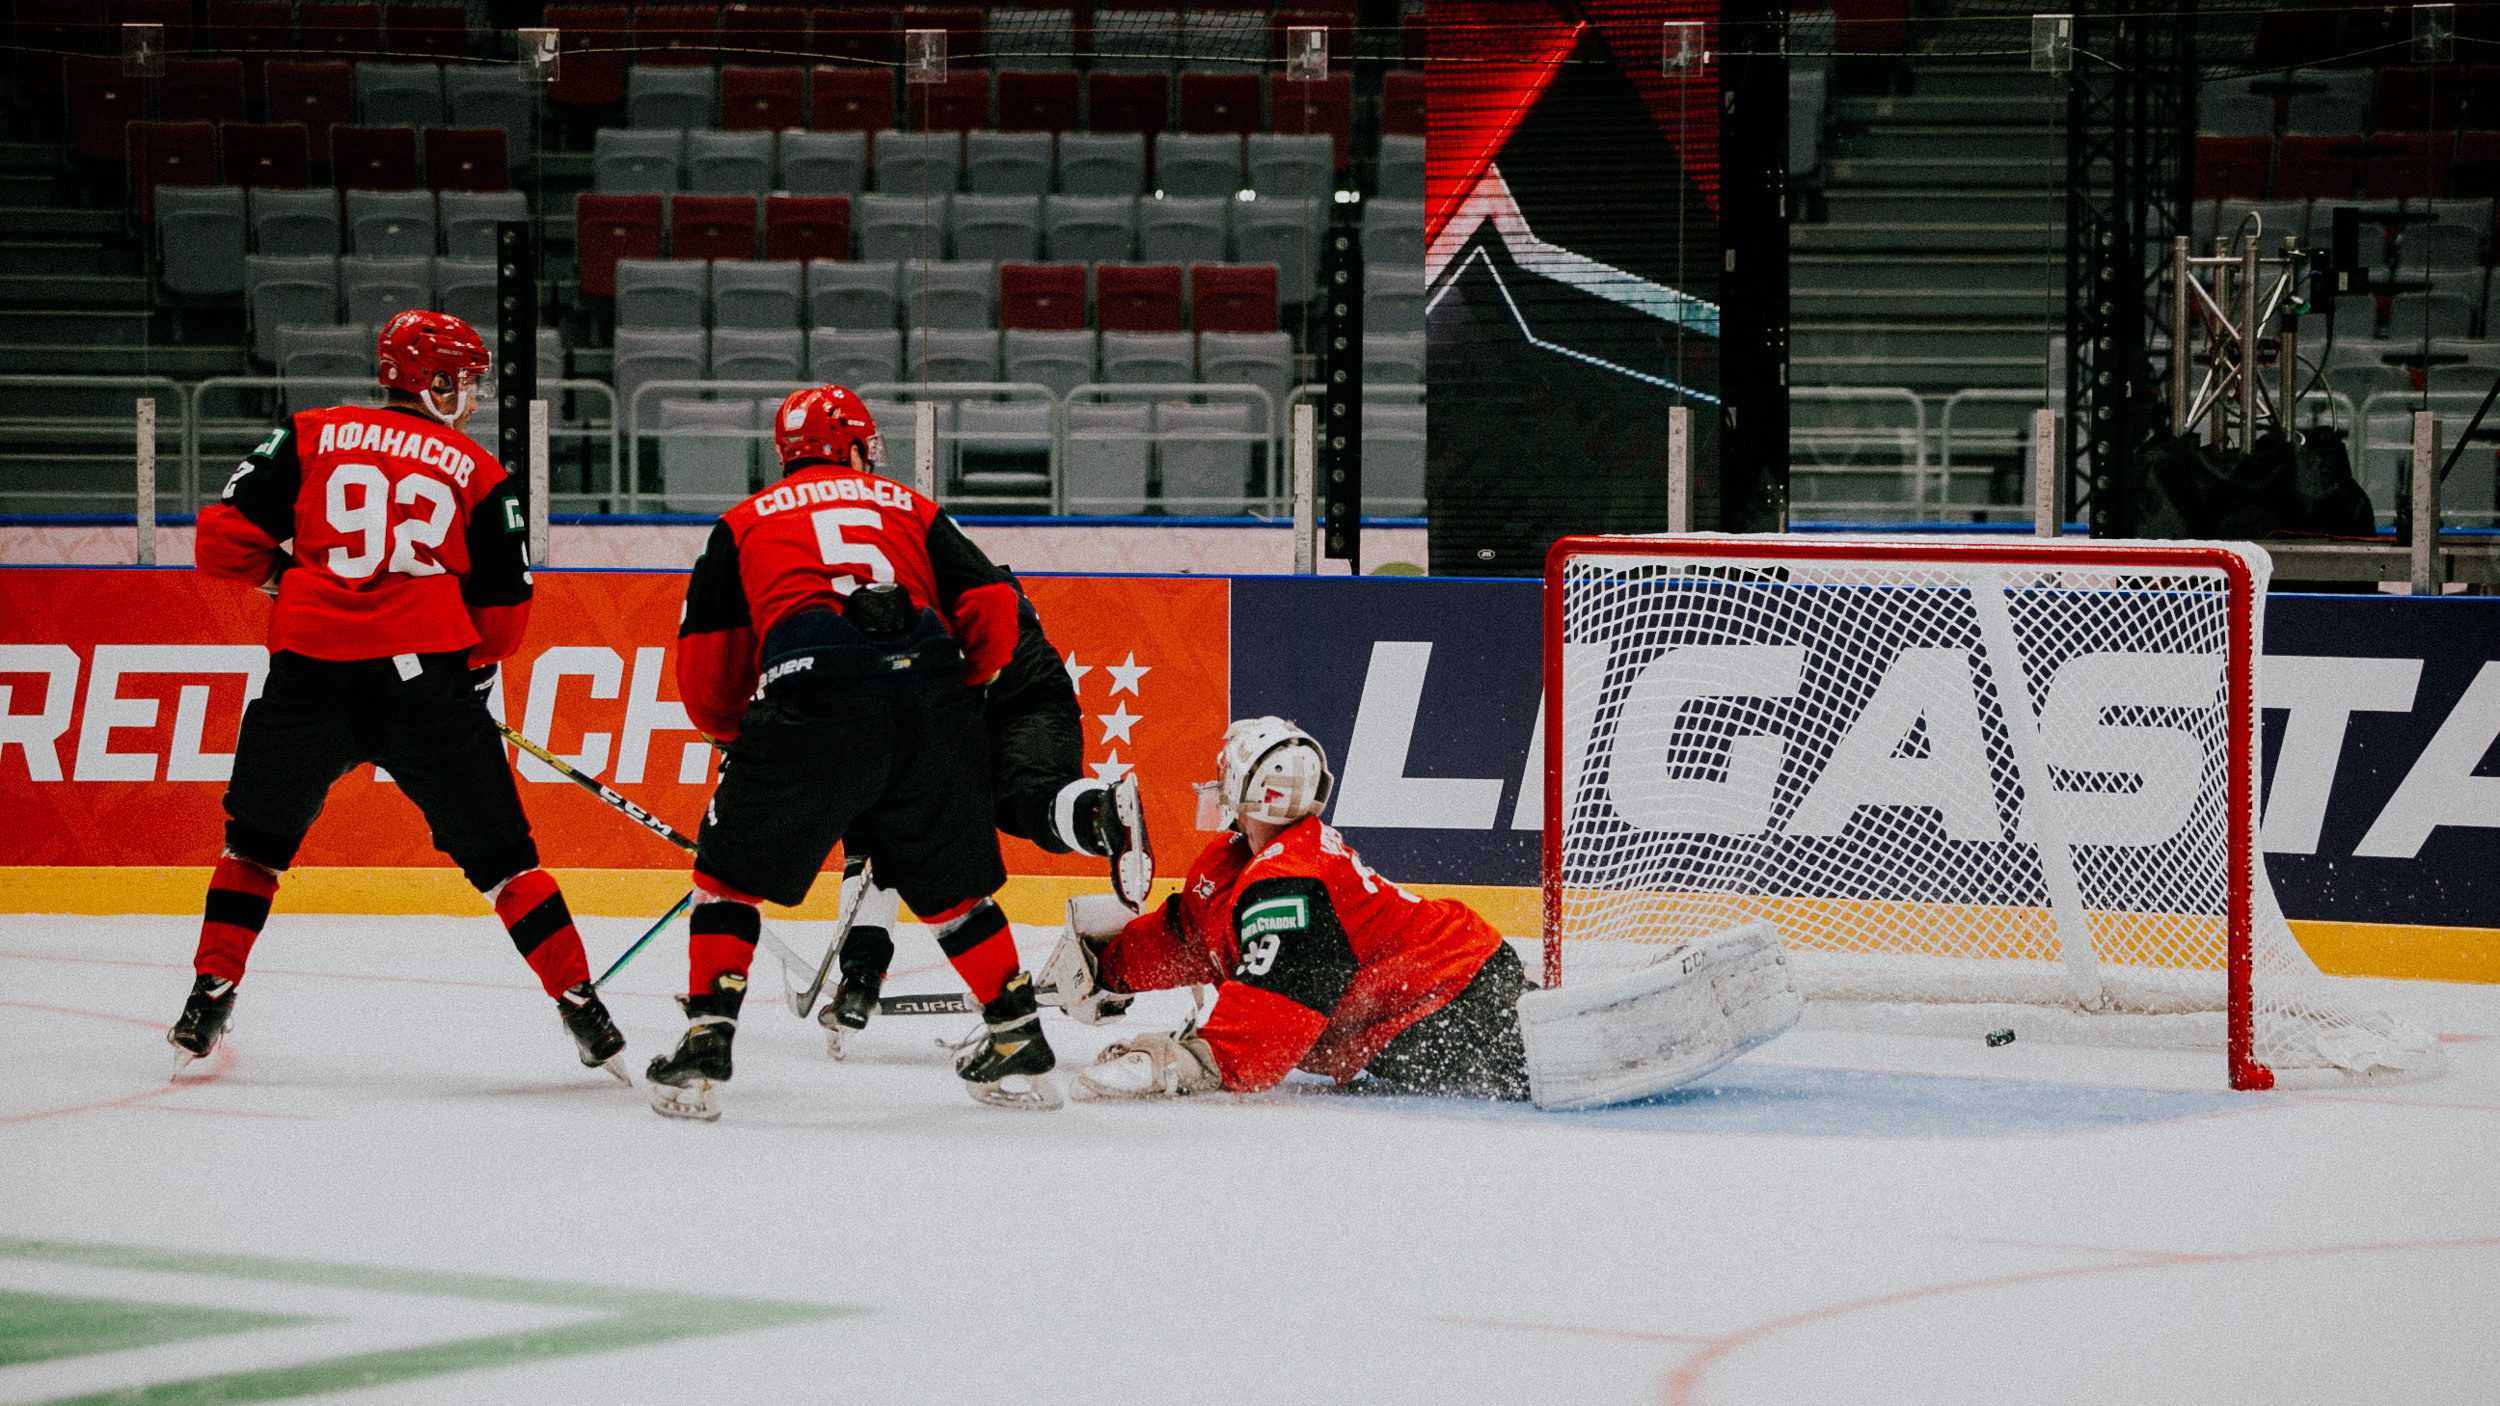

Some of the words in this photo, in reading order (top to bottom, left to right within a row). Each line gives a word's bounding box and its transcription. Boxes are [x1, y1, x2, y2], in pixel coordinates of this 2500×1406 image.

[318, 422, 475, 488] АФАНАСОВ
[326, 464, 456, 577] 92
[811, 508, 895, 597] 5
[600, 785, 673, 836] CCM
[894, 1000, 965, 1013] SUPR
